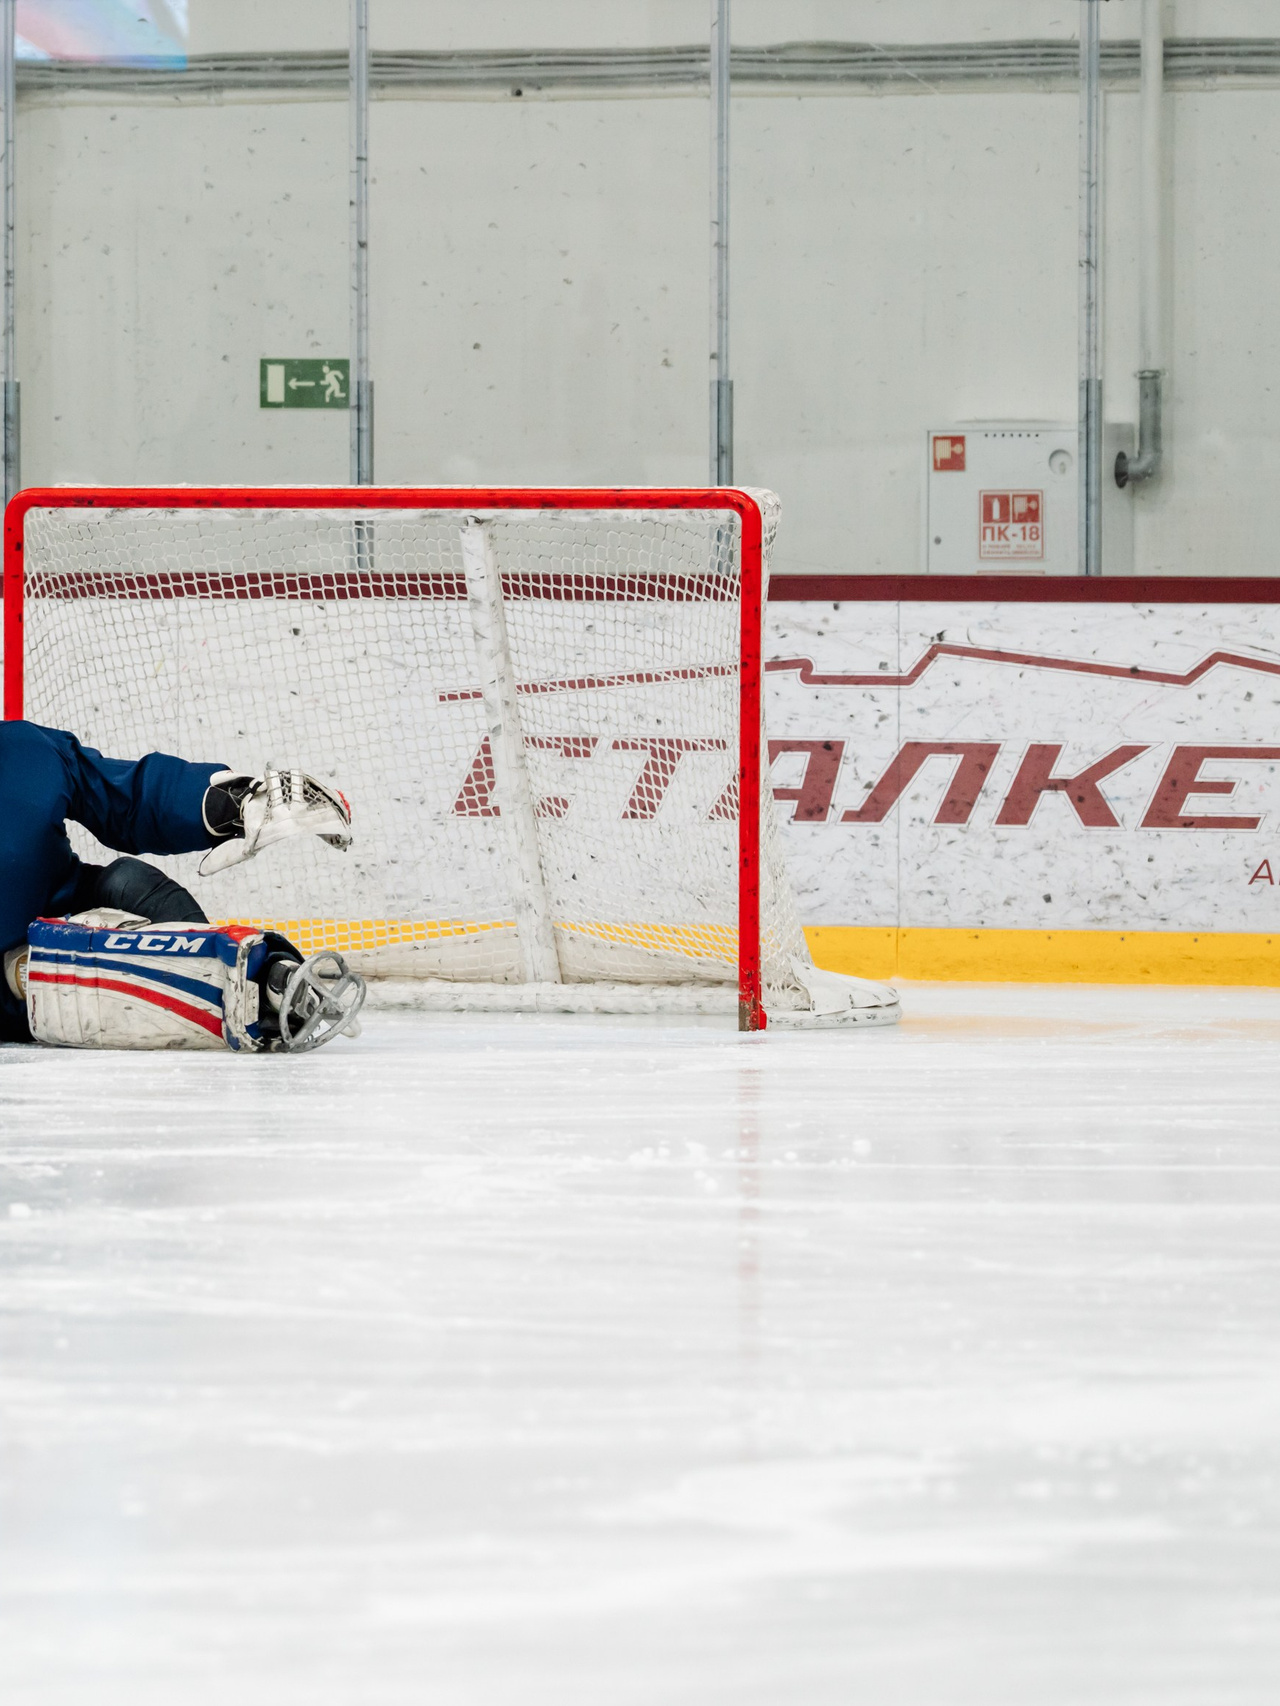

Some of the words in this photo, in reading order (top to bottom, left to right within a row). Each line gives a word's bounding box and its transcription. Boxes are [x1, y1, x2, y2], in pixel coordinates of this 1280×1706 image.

[983, 525, 1040, 542] ПК-18
[447, 735, 1280, 833] СТАЛКЕ
[104, 933, 206, 953] CCM
